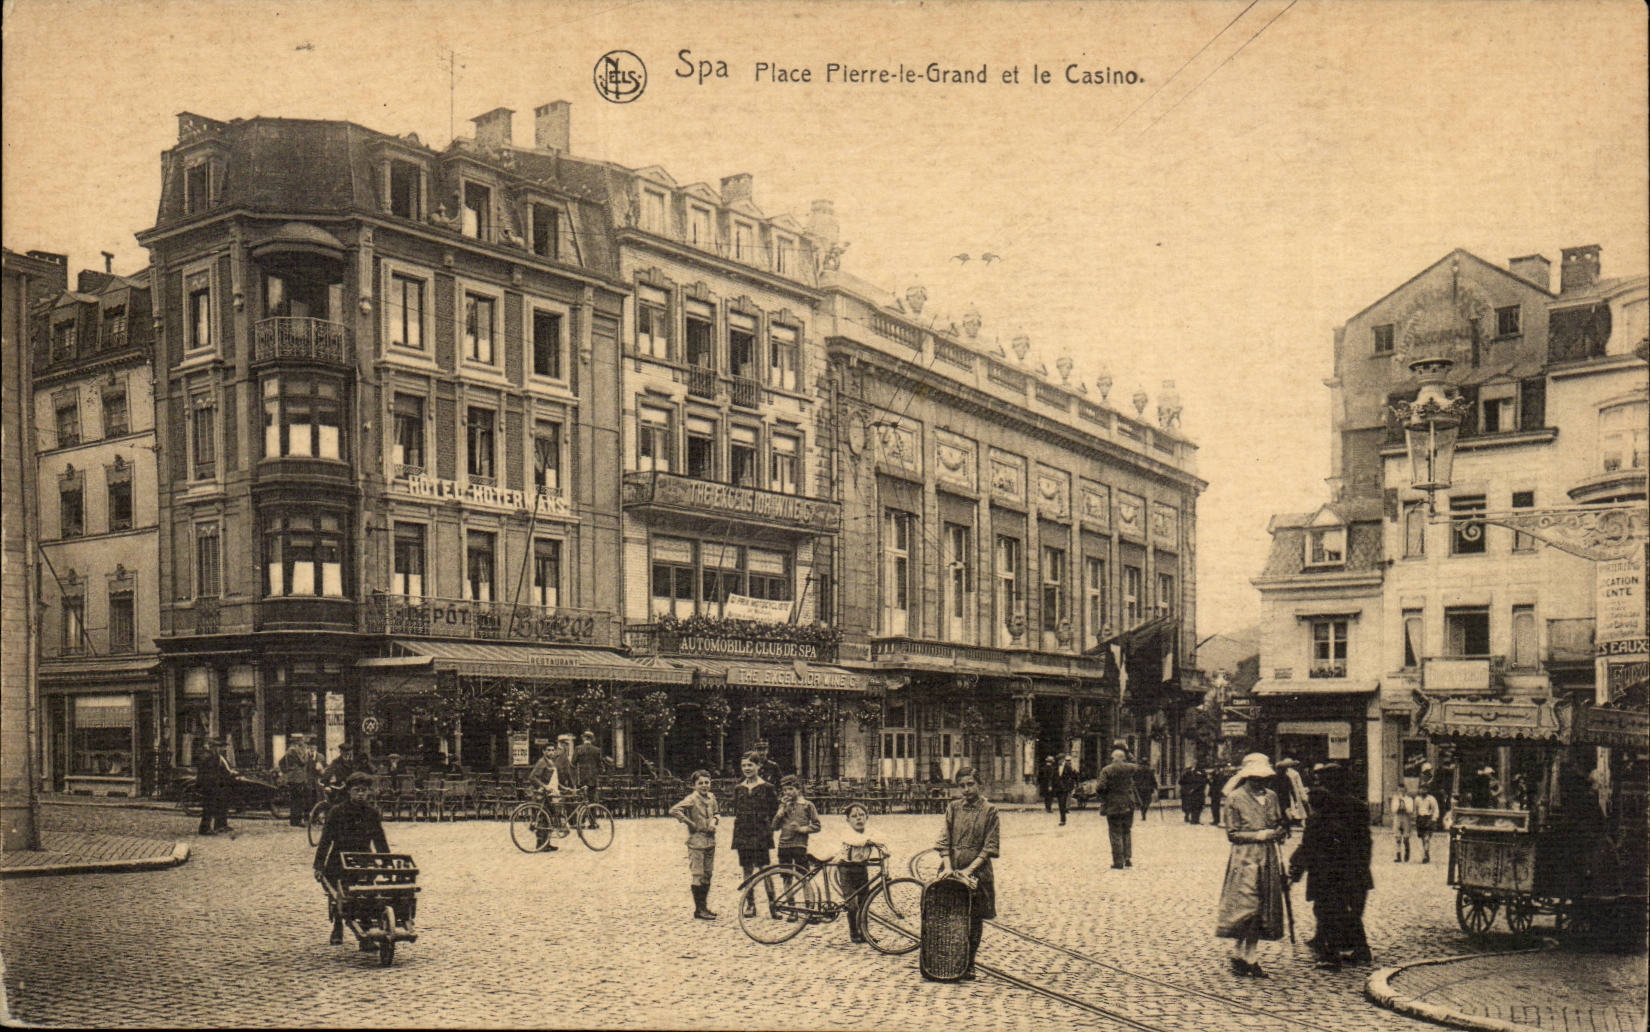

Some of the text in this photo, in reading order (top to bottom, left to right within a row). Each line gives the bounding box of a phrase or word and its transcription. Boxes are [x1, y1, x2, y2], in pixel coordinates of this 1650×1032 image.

[680, 636, 818, 659] AUTOMOBILE CLUB DE SPA
[529, 655, 580, 668] RESTAURANT
[739, 668, 759, 684] THE
